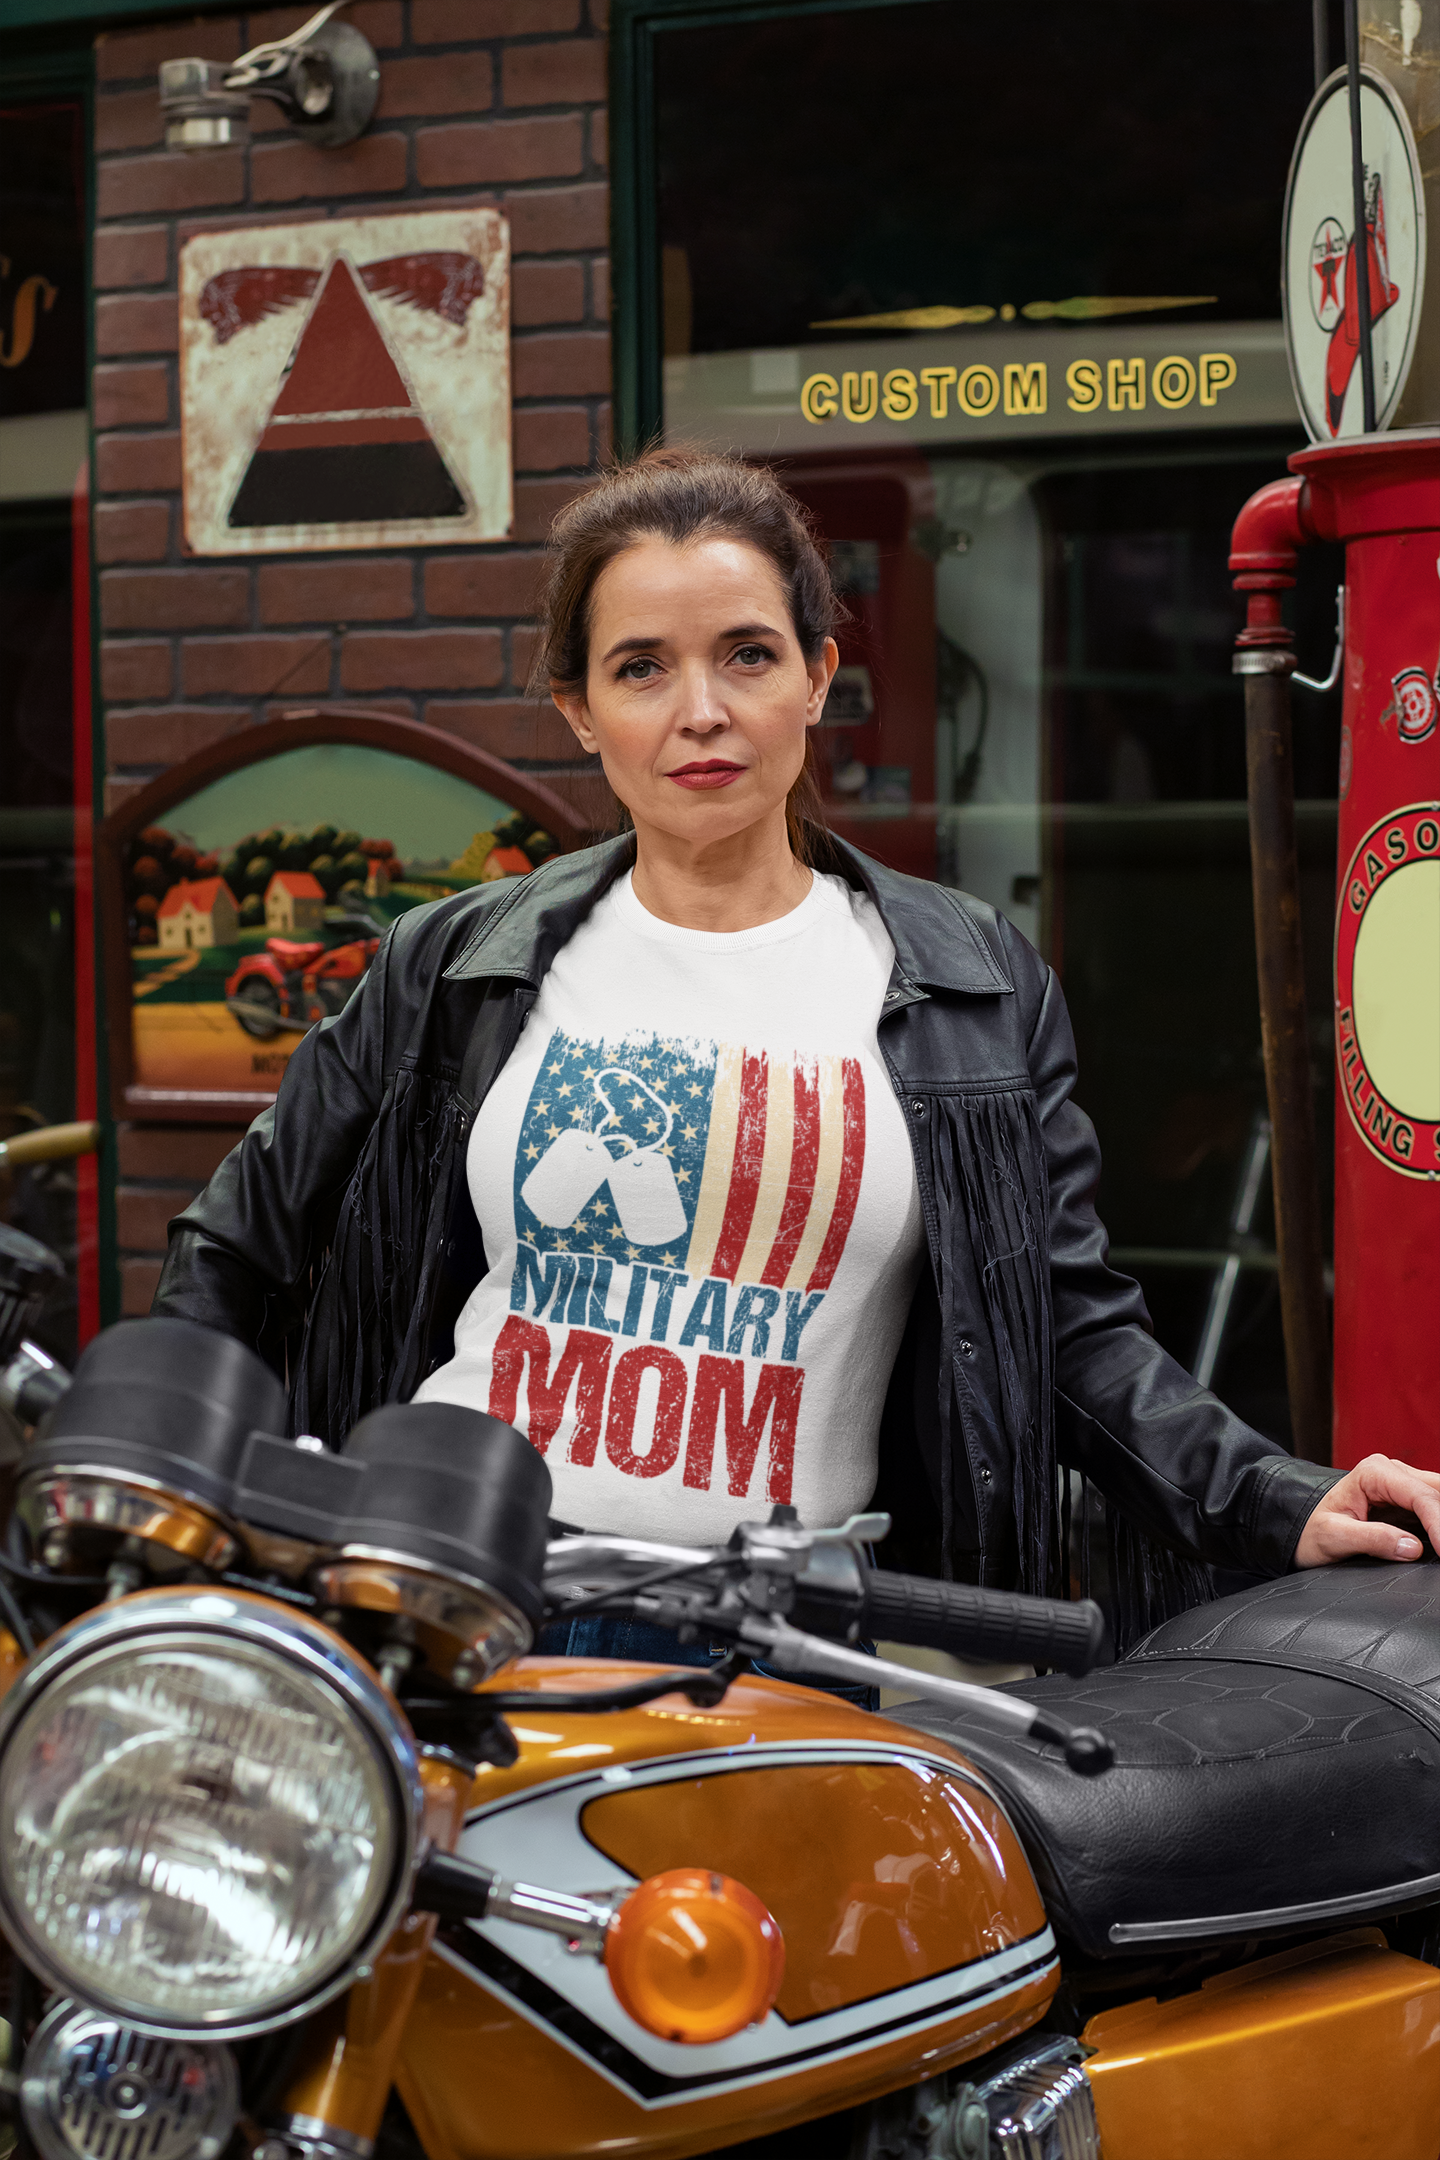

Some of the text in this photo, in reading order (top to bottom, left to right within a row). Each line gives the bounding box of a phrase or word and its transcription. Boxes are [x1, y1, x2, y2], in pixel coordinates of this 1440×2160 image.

[801, 353, 1237, 424] CUSTOM SHOP
[1340, 1005, 1415, 1160] FILLING
[509, 1243, 825, 1361] MILITARY
[487, 1314, 805, 1505] MOM
